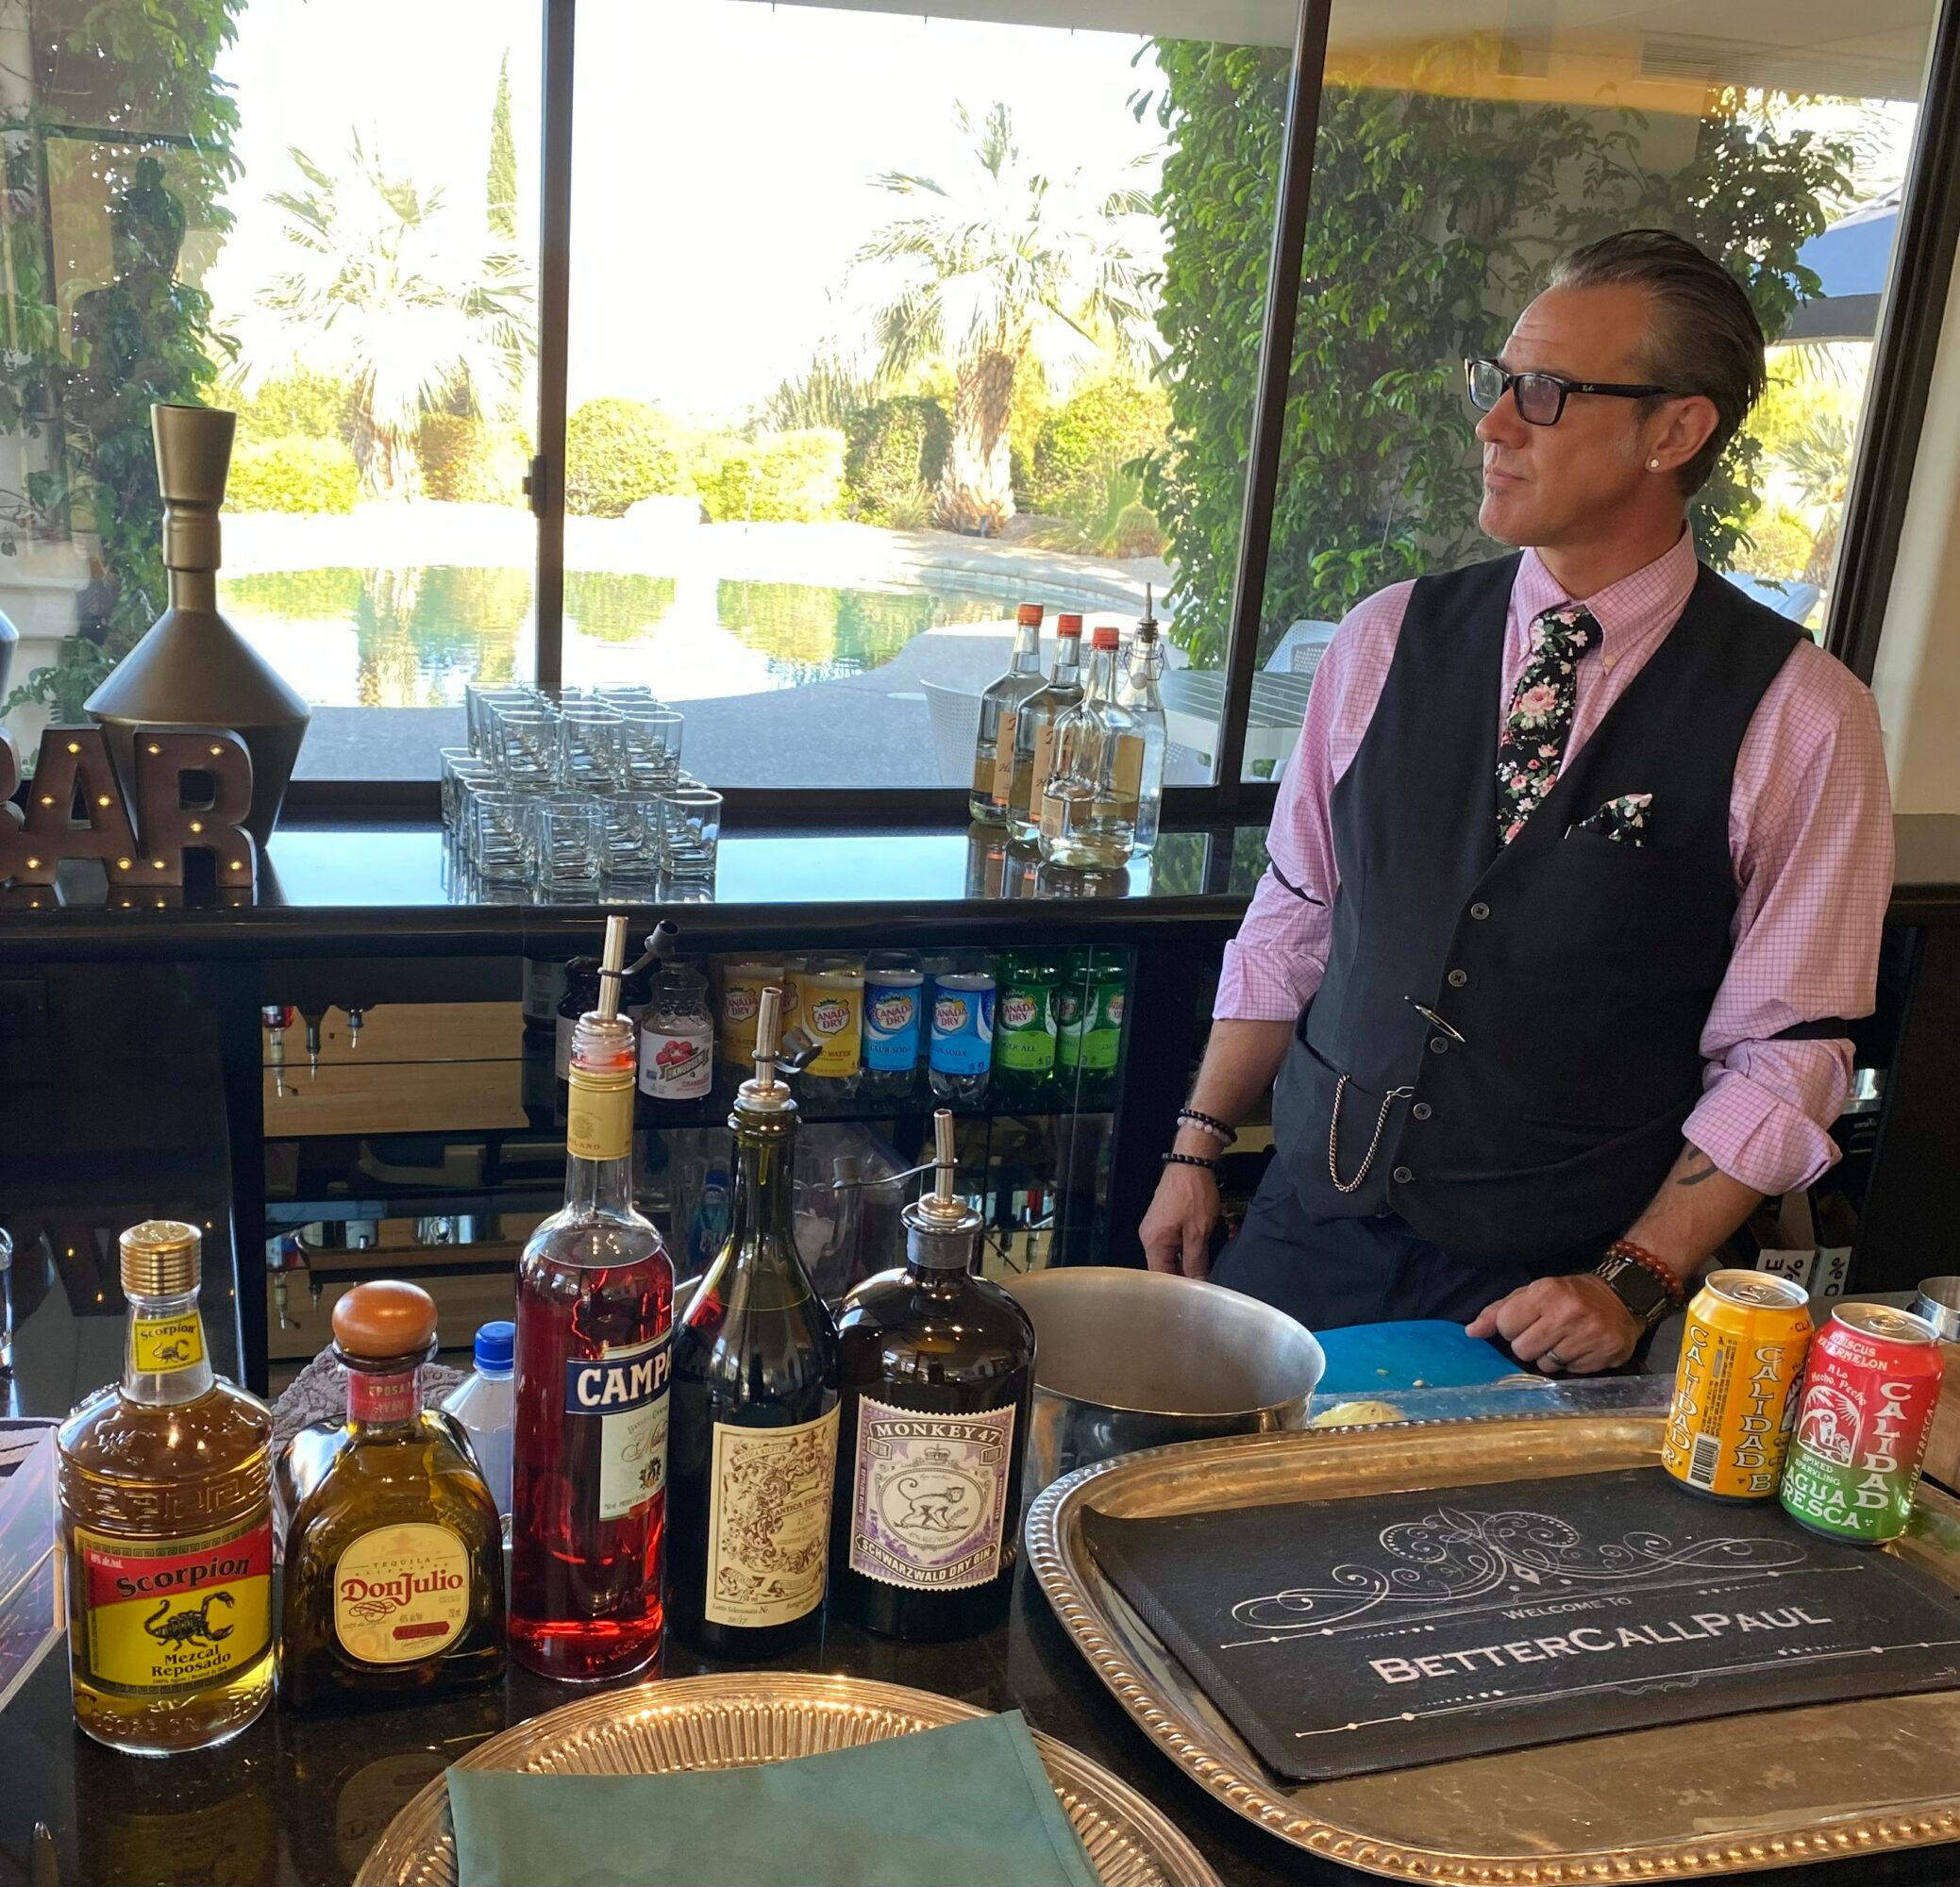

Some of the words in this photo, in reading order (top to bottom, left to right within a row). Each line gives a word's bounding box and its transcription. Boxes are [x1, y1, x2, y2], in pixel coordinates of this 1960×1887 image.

[0, 724, 257, 887] AR
[812, 1009, 850, 1024] CANADA
[823, 1019, 844, 1029] DRY
[885, 1016, 907, 1026] DRY
[941, 1016, 959, 1026] DRY
[1009, 1012, 1028, 1022] DRY
[141, 1323, 195, 1341] Scorpion
[1733, 1346, 1785, 1468] CALIDAD
[874, 1422, 978, 1439] MONKEY
[978, 1429, 1000, 1444] 47
[1852, 1382, 1914, 1510] CALIDAD
[1794, 1458, 1841, 1486] SPARKLING
[1801, 1453, 1834, 1474] SPIKED
[1785, 1465, 1847, 1510] AGUA
[372, 1557, 431, 1569] TEQUILA
[862, 1540, 946, 1582] SCHWARZWALD
[948, 1558, 972, 1578] DRY
[973, 1548, 992, 1565] GIN
[116, 1557, 251, 1598] Scorpion
[1501, 1599, 1605, 1620] WELCOME
[151, 1653, 231, 1678] Reposado
[165, 1644, 219, 1666] Mezcal
